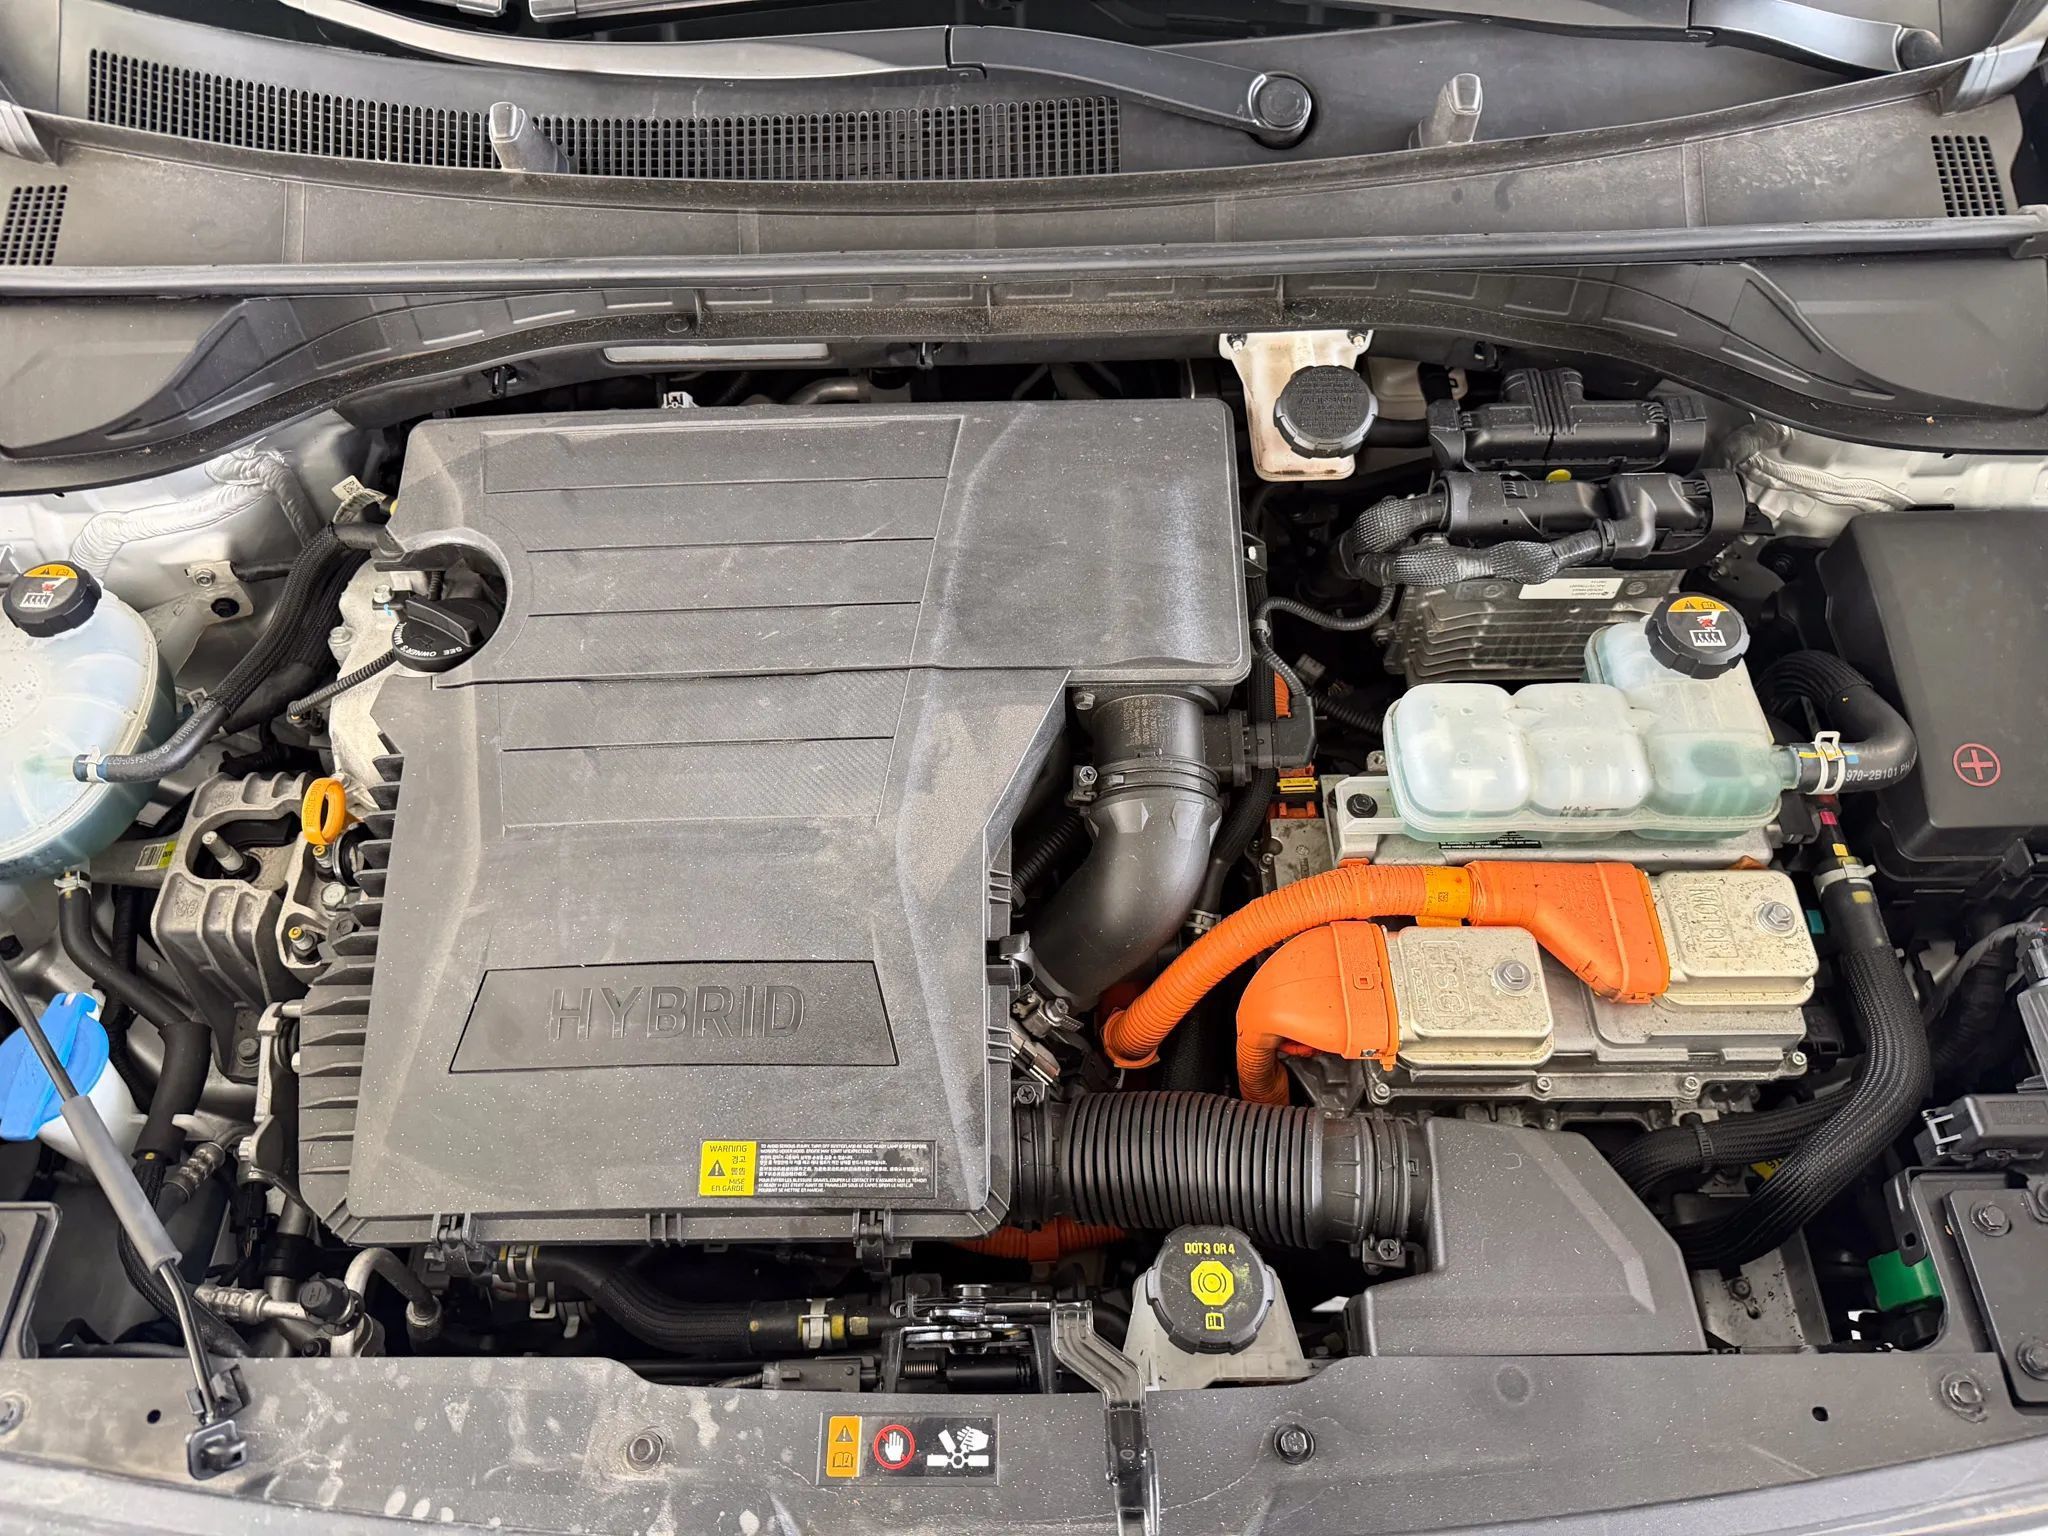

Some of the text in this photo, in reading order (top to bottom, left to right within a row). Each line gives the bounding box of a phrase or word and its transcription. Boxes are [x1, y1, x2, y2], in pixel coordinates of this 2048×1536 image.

[400, 645, 437, 657] OWNER'S
[443, 646, 463, 656] SEE
[549, 985, 804, 1040] HYBRID
[709, 1144, 747, 1153] WARNING
[722, 1184, 745, 1192] GARDE
[1184, 1242, 1236, 1255] DOT3 OR 4
